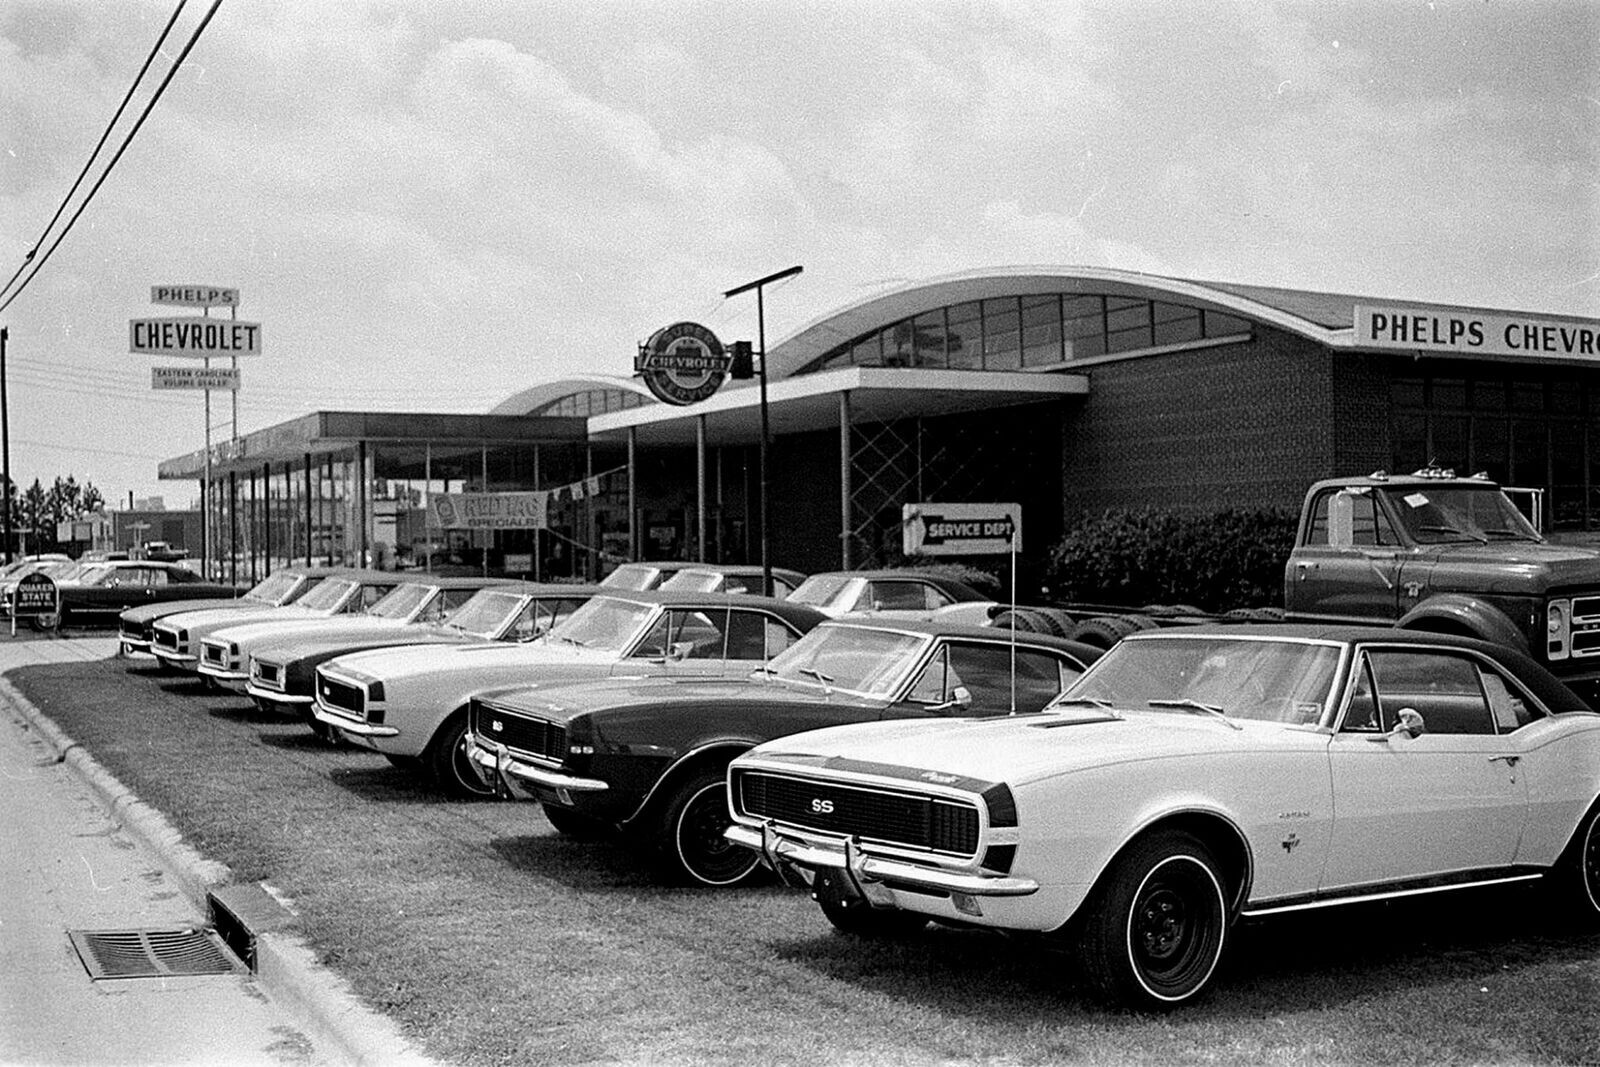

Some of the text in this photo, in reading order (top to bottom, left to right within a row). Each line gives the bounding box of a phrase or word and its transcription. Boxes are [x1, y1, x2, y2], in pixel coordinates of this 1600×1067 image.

[158, 289, 233, 302] PHELPS
[134, 323, 257, 351] CHEVROLET
[662, 325, 716, 344] SUPER
[1371, 313, 1600, 355] PHELPS CHEVR
[650, 356, 725, 369] CHEVROLET
[657, 375, 721, 400] SERVICE
[465, 496, 500, 517] RED
[929, 523, 1011, 537] SERVICE DEPT
[19, 583, 54, 592] QUAKER
[22, 592, 51, 601] STATE
[811, 799, 834, 813] SS
